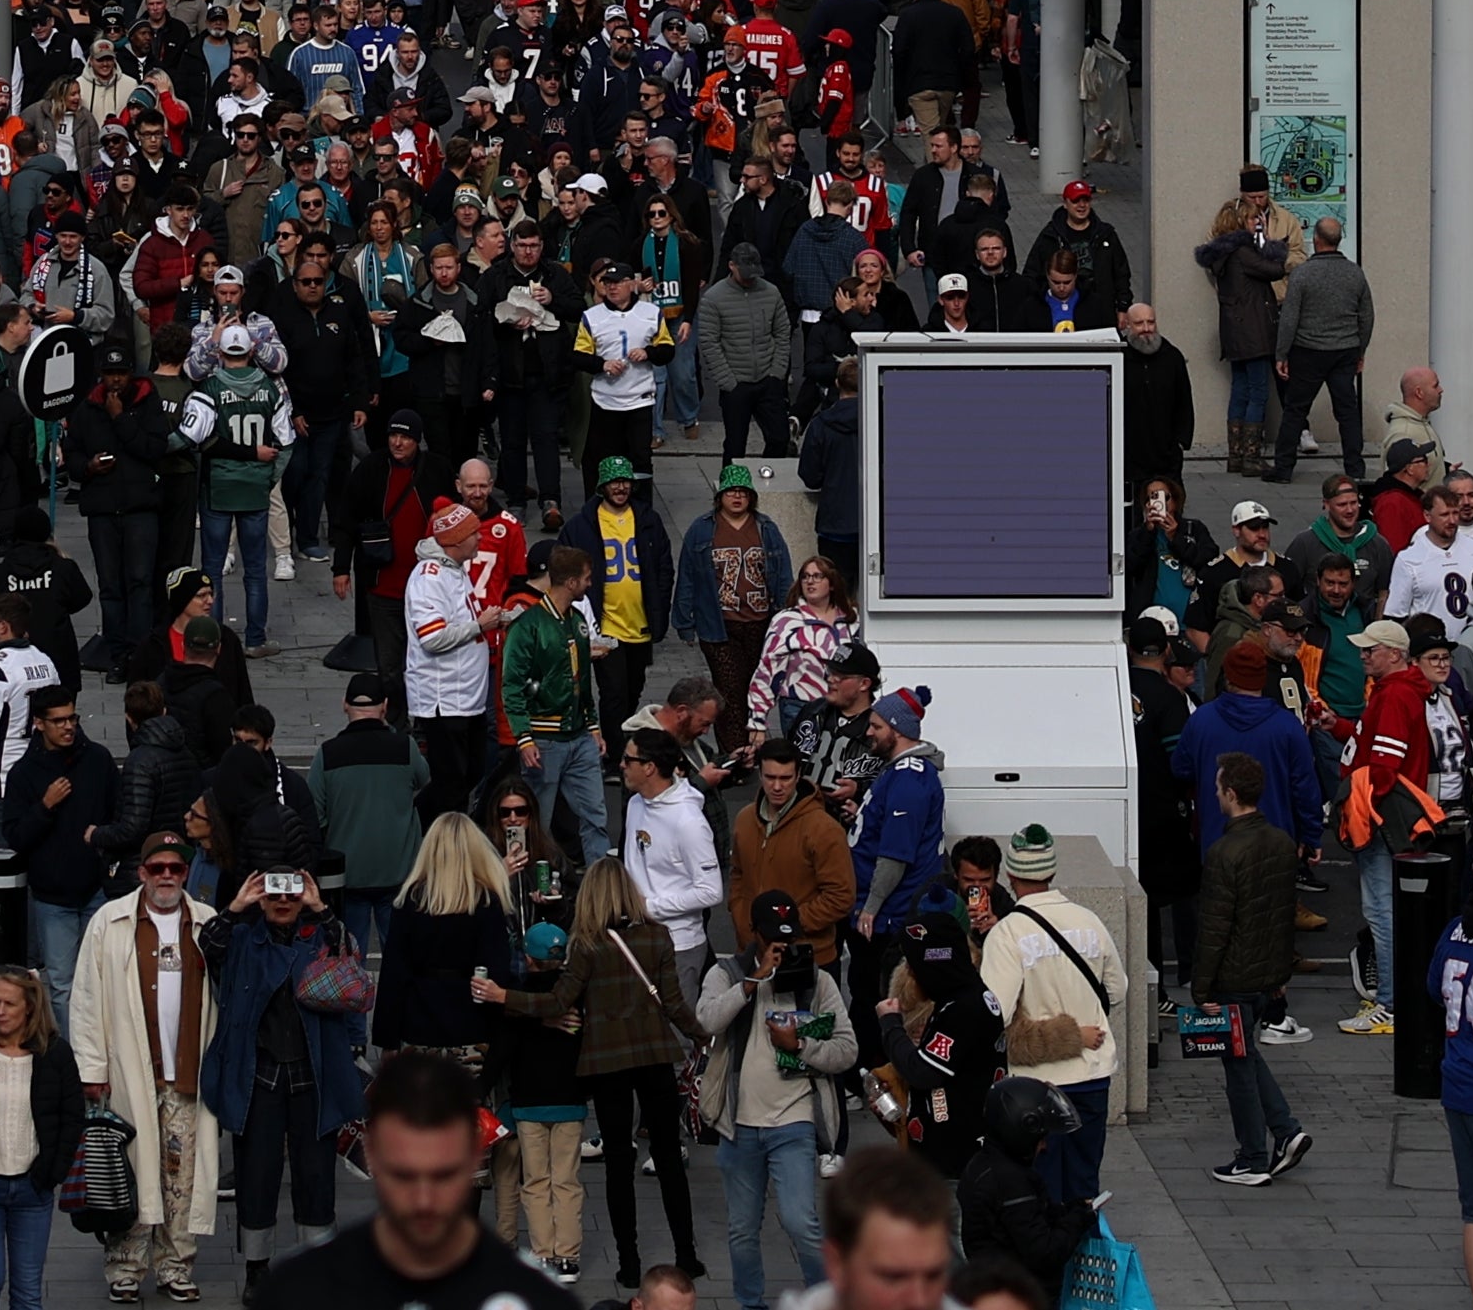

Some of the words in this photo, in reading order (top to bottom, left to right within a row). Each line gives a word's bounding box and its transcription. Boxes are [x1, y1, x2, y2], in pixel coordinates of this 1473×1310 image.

[522, 48, 542, 80] 7
[747, 50, 779, 81] 15
[42, 394, 75, 410] BAGDROP
[227, 413, 265, 446] 10
[419, 561, 440, 577] 15
[1443, 572, 1470, 619] 8
[23, 664, 51, 681] BRADY
[1194, 1015, 1226, 1027] JAGUARS
[1196, 1041, 1226, 1053] TEXANS
